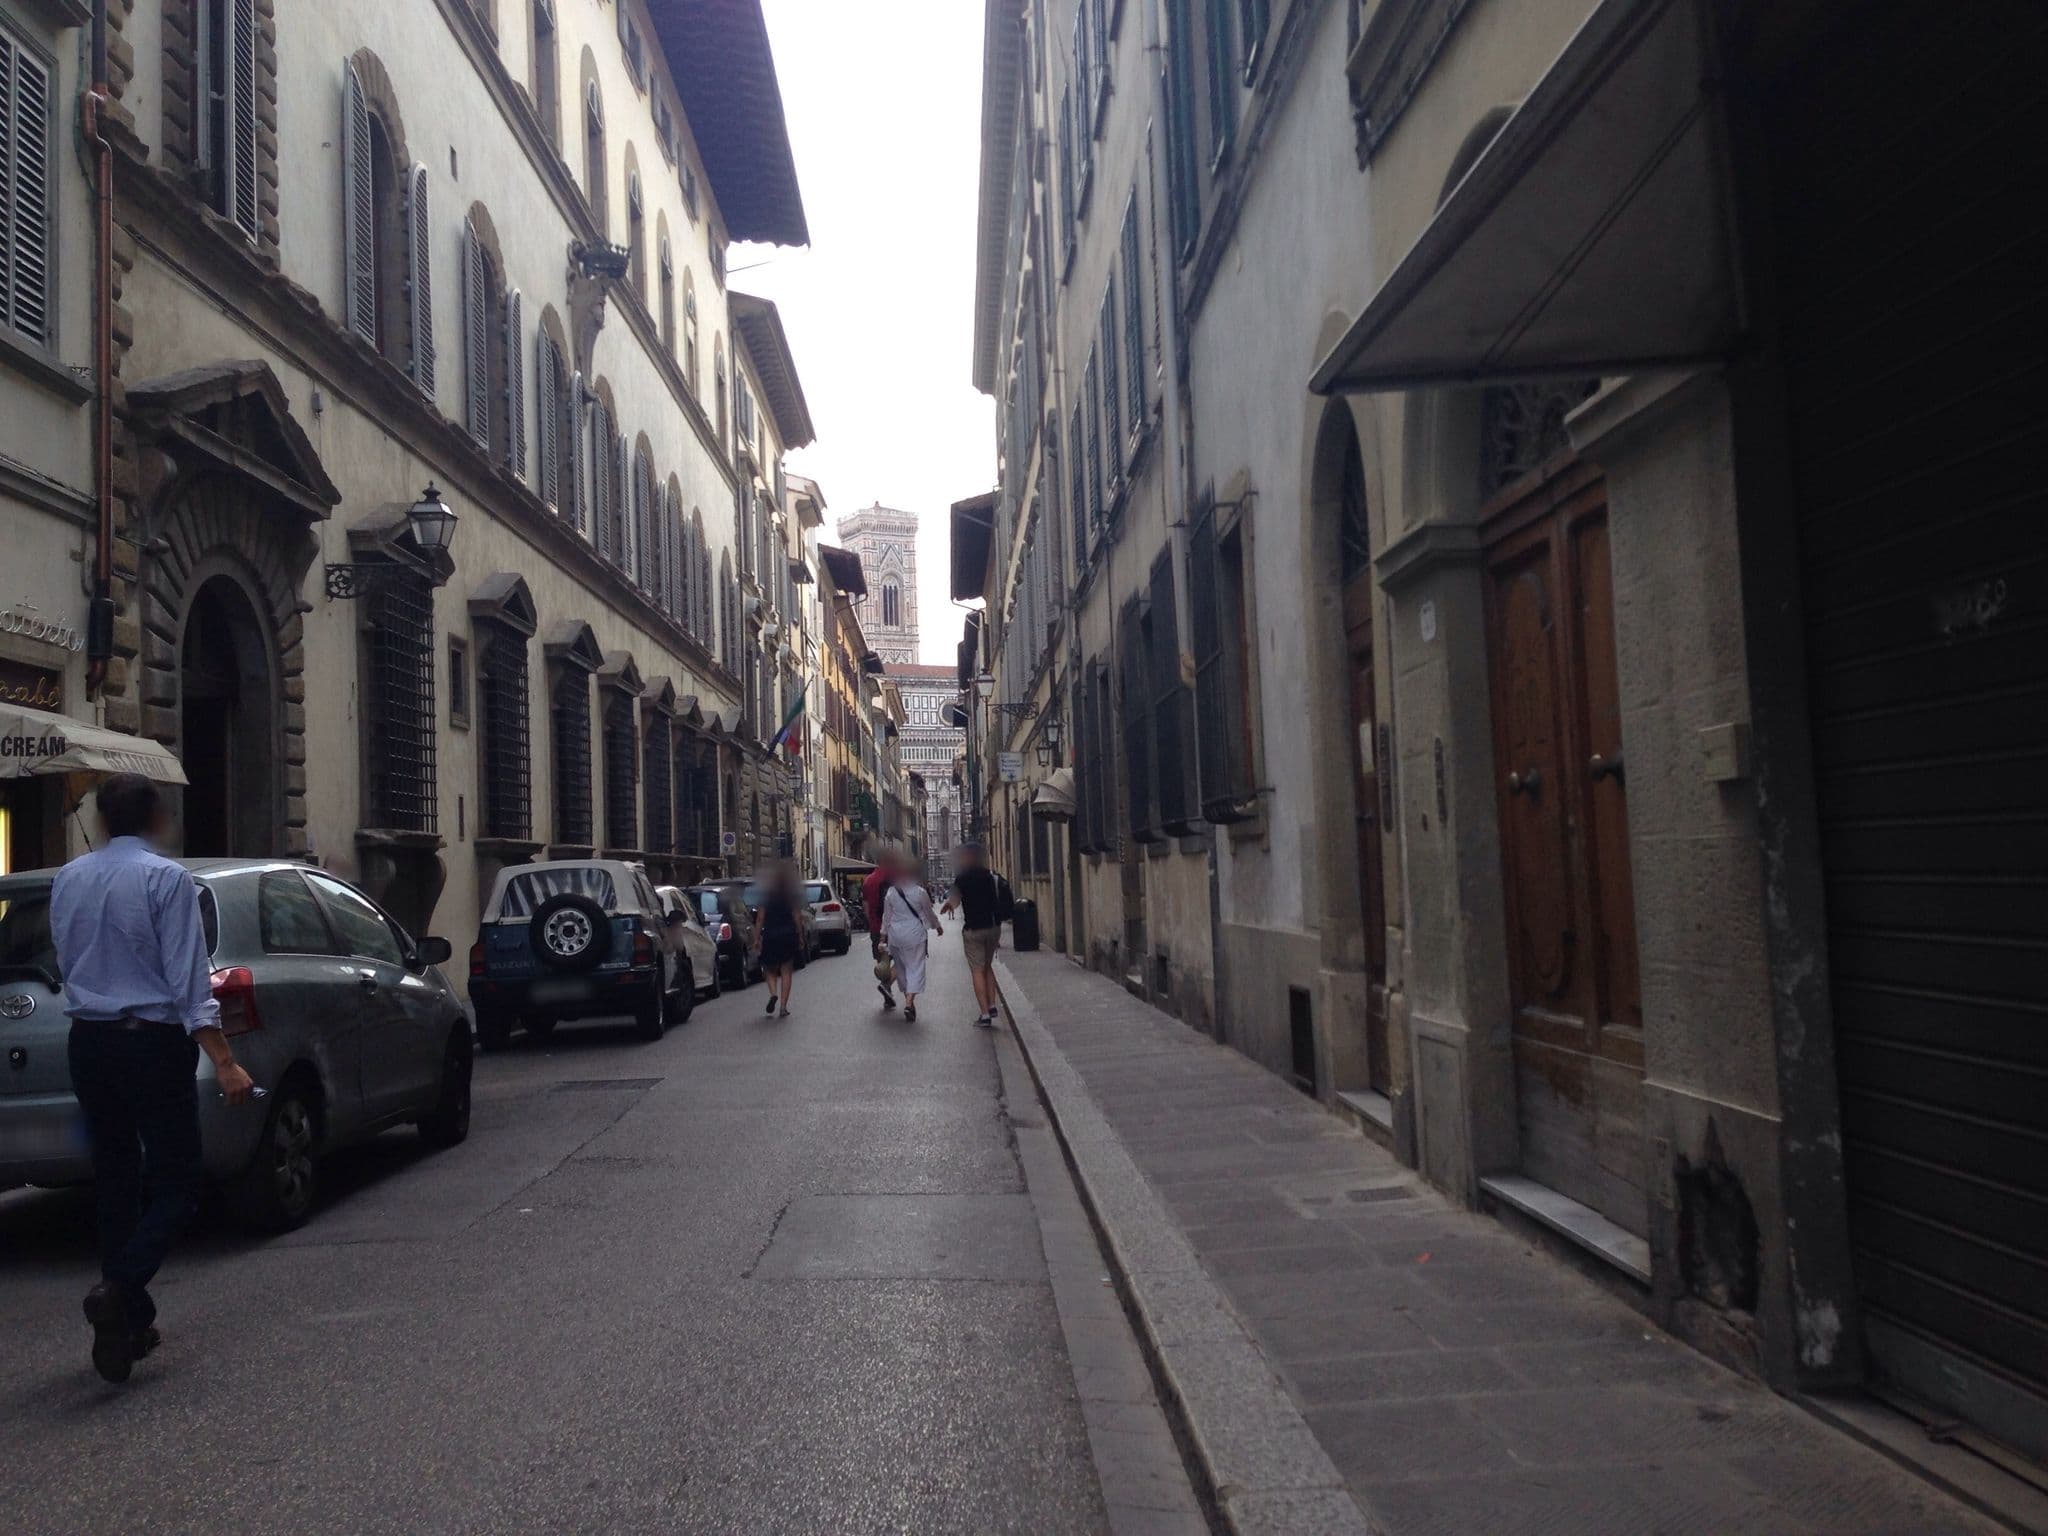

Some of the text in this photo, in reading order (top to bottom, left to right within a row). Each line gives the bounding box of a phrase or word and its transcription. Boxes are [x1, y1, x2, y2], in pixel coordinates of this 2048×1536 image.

[1, 735, 66, 757] CREAM
[103, 750, 171, 779] GELATERIA
[489, 959, 536, 970] SUZUKI
